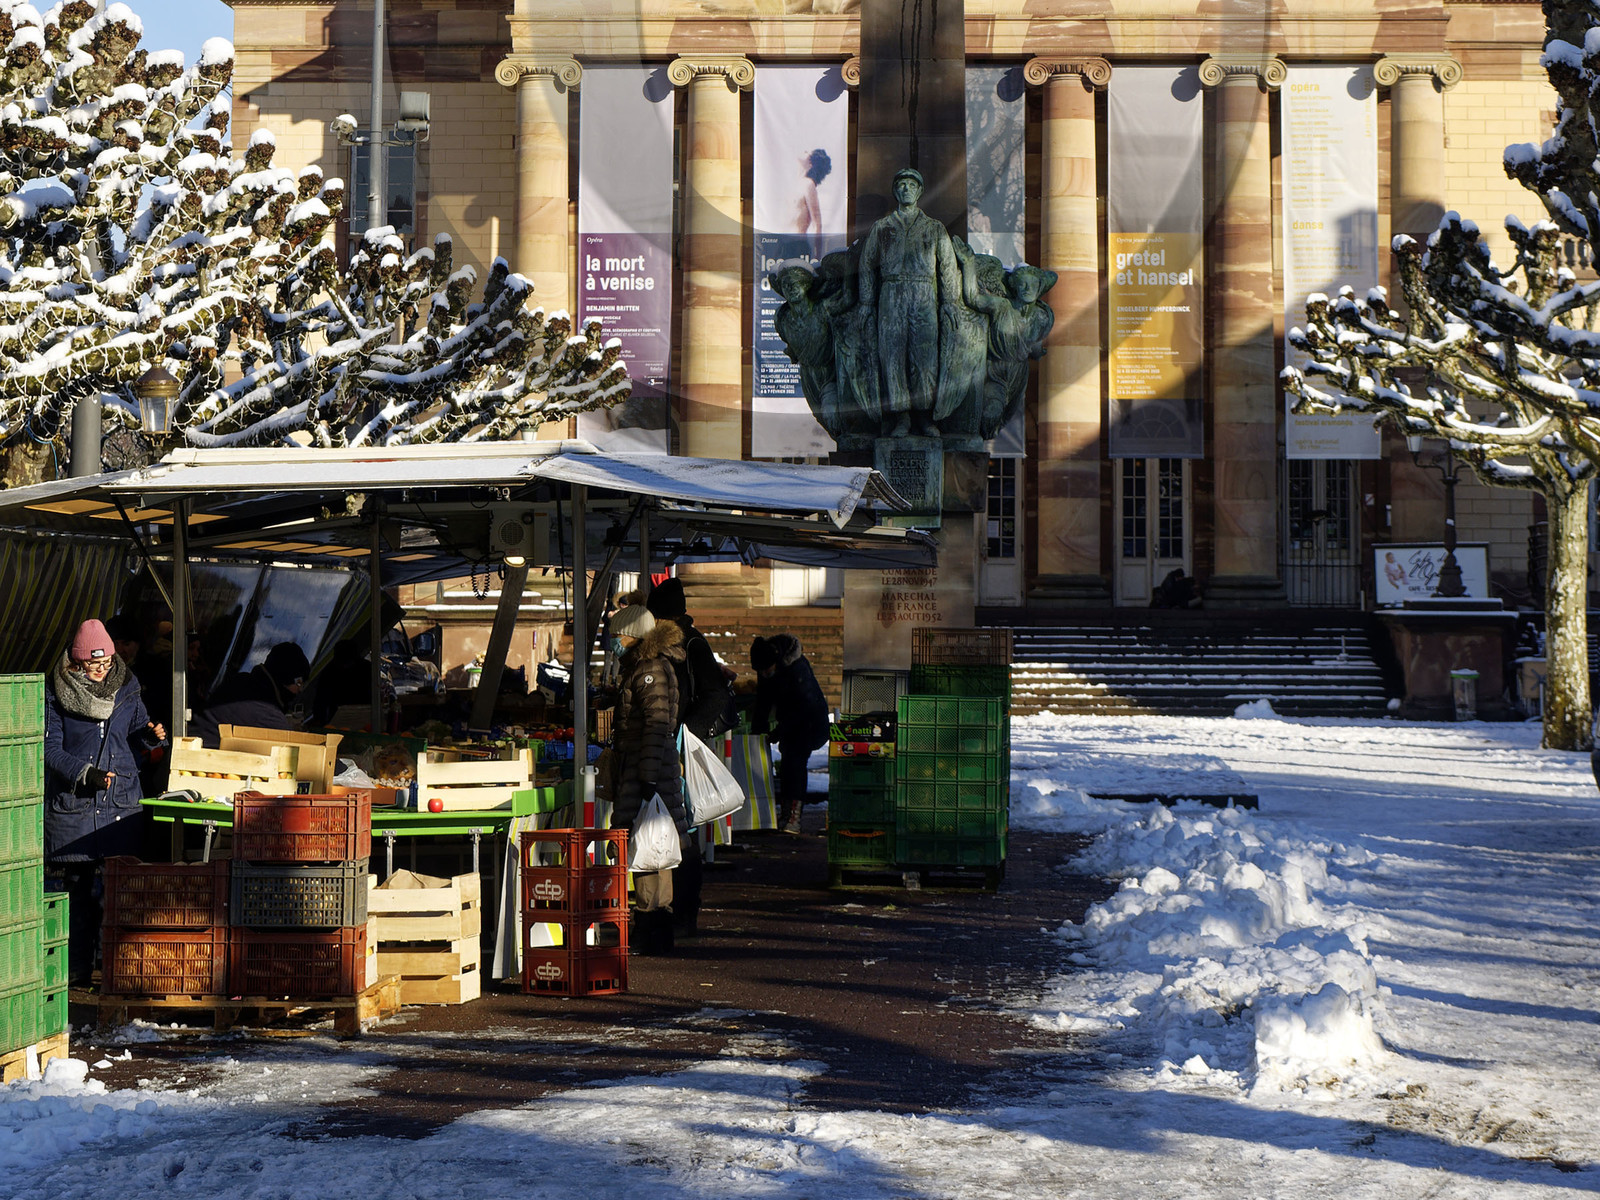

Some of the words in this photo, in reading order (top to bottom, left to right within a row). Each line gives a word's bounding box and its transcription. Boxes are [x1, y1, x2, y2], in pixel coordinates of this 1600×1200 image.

[1290, 82, 1320, 93] opéra
[1292, 220, 1324, 230] danse
[586, 254, 600, 271] la
[605, 255, 645, 271] mort
[1116, 249, 1165, 270] gretel
[586, 273, 596, 290] à
[600, 273, 654, 290] venise
[1116, 269, 1133, 285] et
[1138, 268, 1193, 285] hansel
[882, 592, 937, 601] MARECHAL
[882, 602, 894, 610] DE
[897, 602, 937, 612] FRANCE
[852, 726, 872, 735] natti
